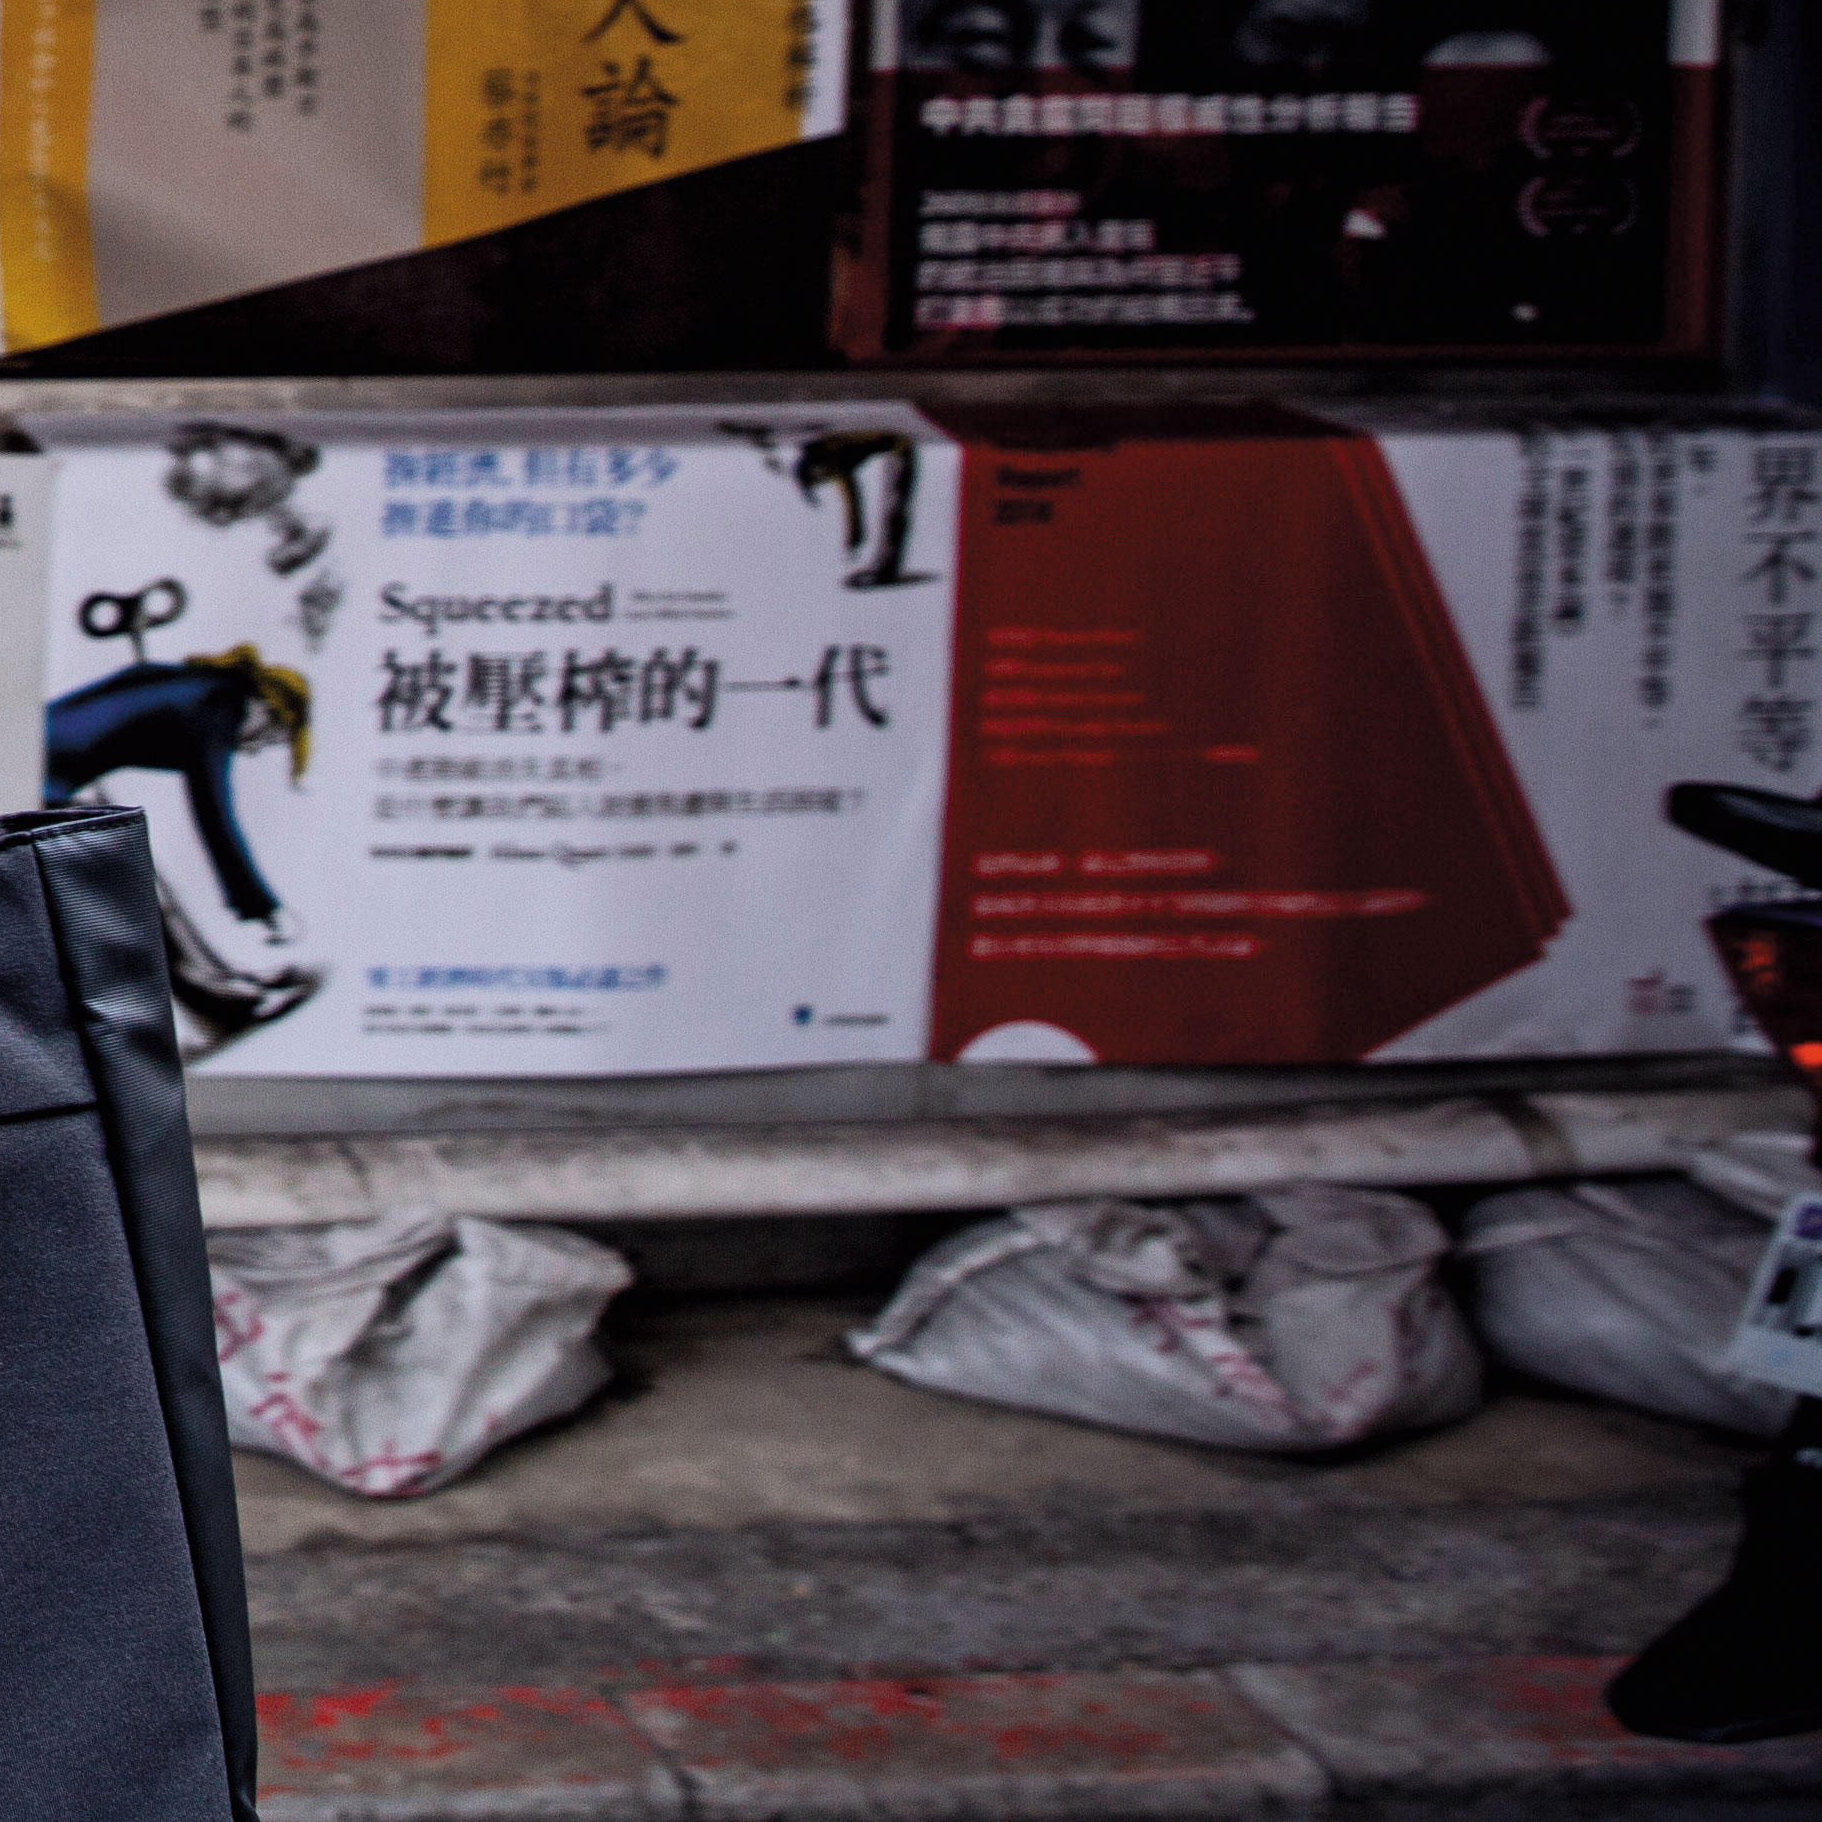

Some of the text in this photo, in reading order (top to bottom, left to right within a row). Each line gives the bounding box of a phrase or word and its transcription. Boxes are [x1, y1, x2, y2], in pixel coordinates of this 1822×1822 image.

[379, 586, 616, 634] Squeezed
[374, 648, 894, 734] 被壓榨的一代
